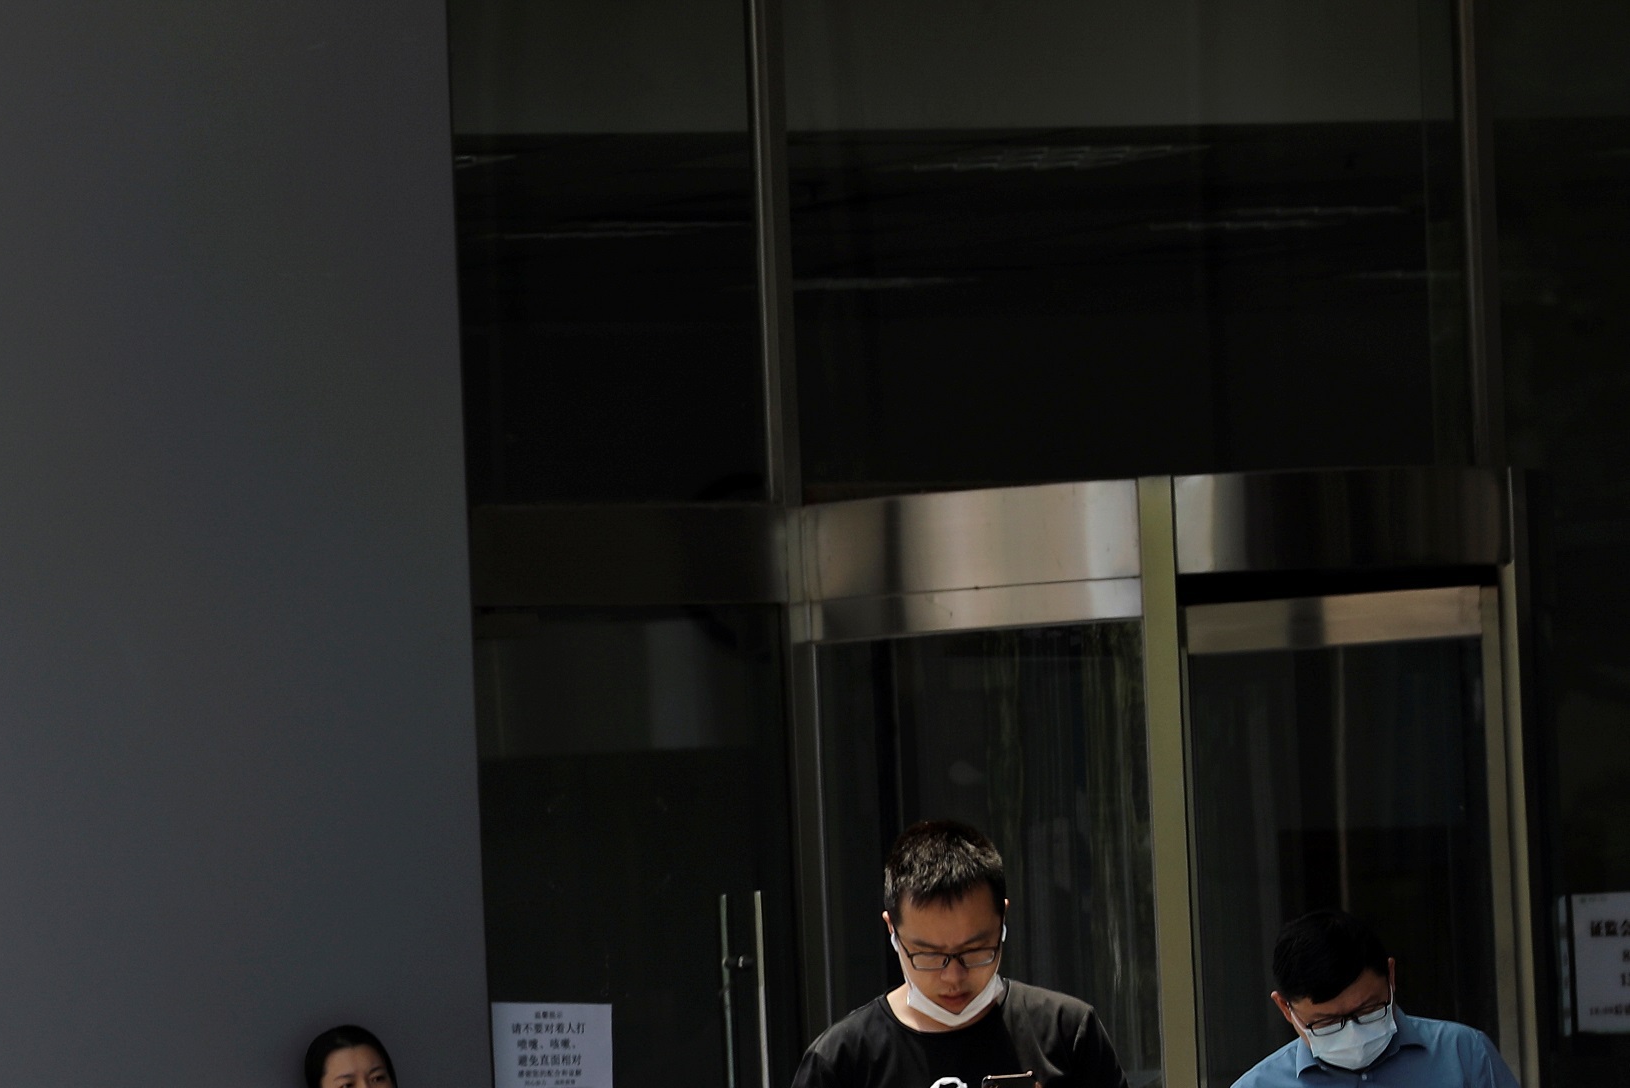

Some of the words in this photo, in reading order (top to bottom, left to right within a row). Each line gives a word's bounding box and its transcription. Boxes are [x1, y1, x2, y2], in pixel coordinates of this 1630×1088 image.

[511, 1021, 585, 1034] 请不要对着人打
